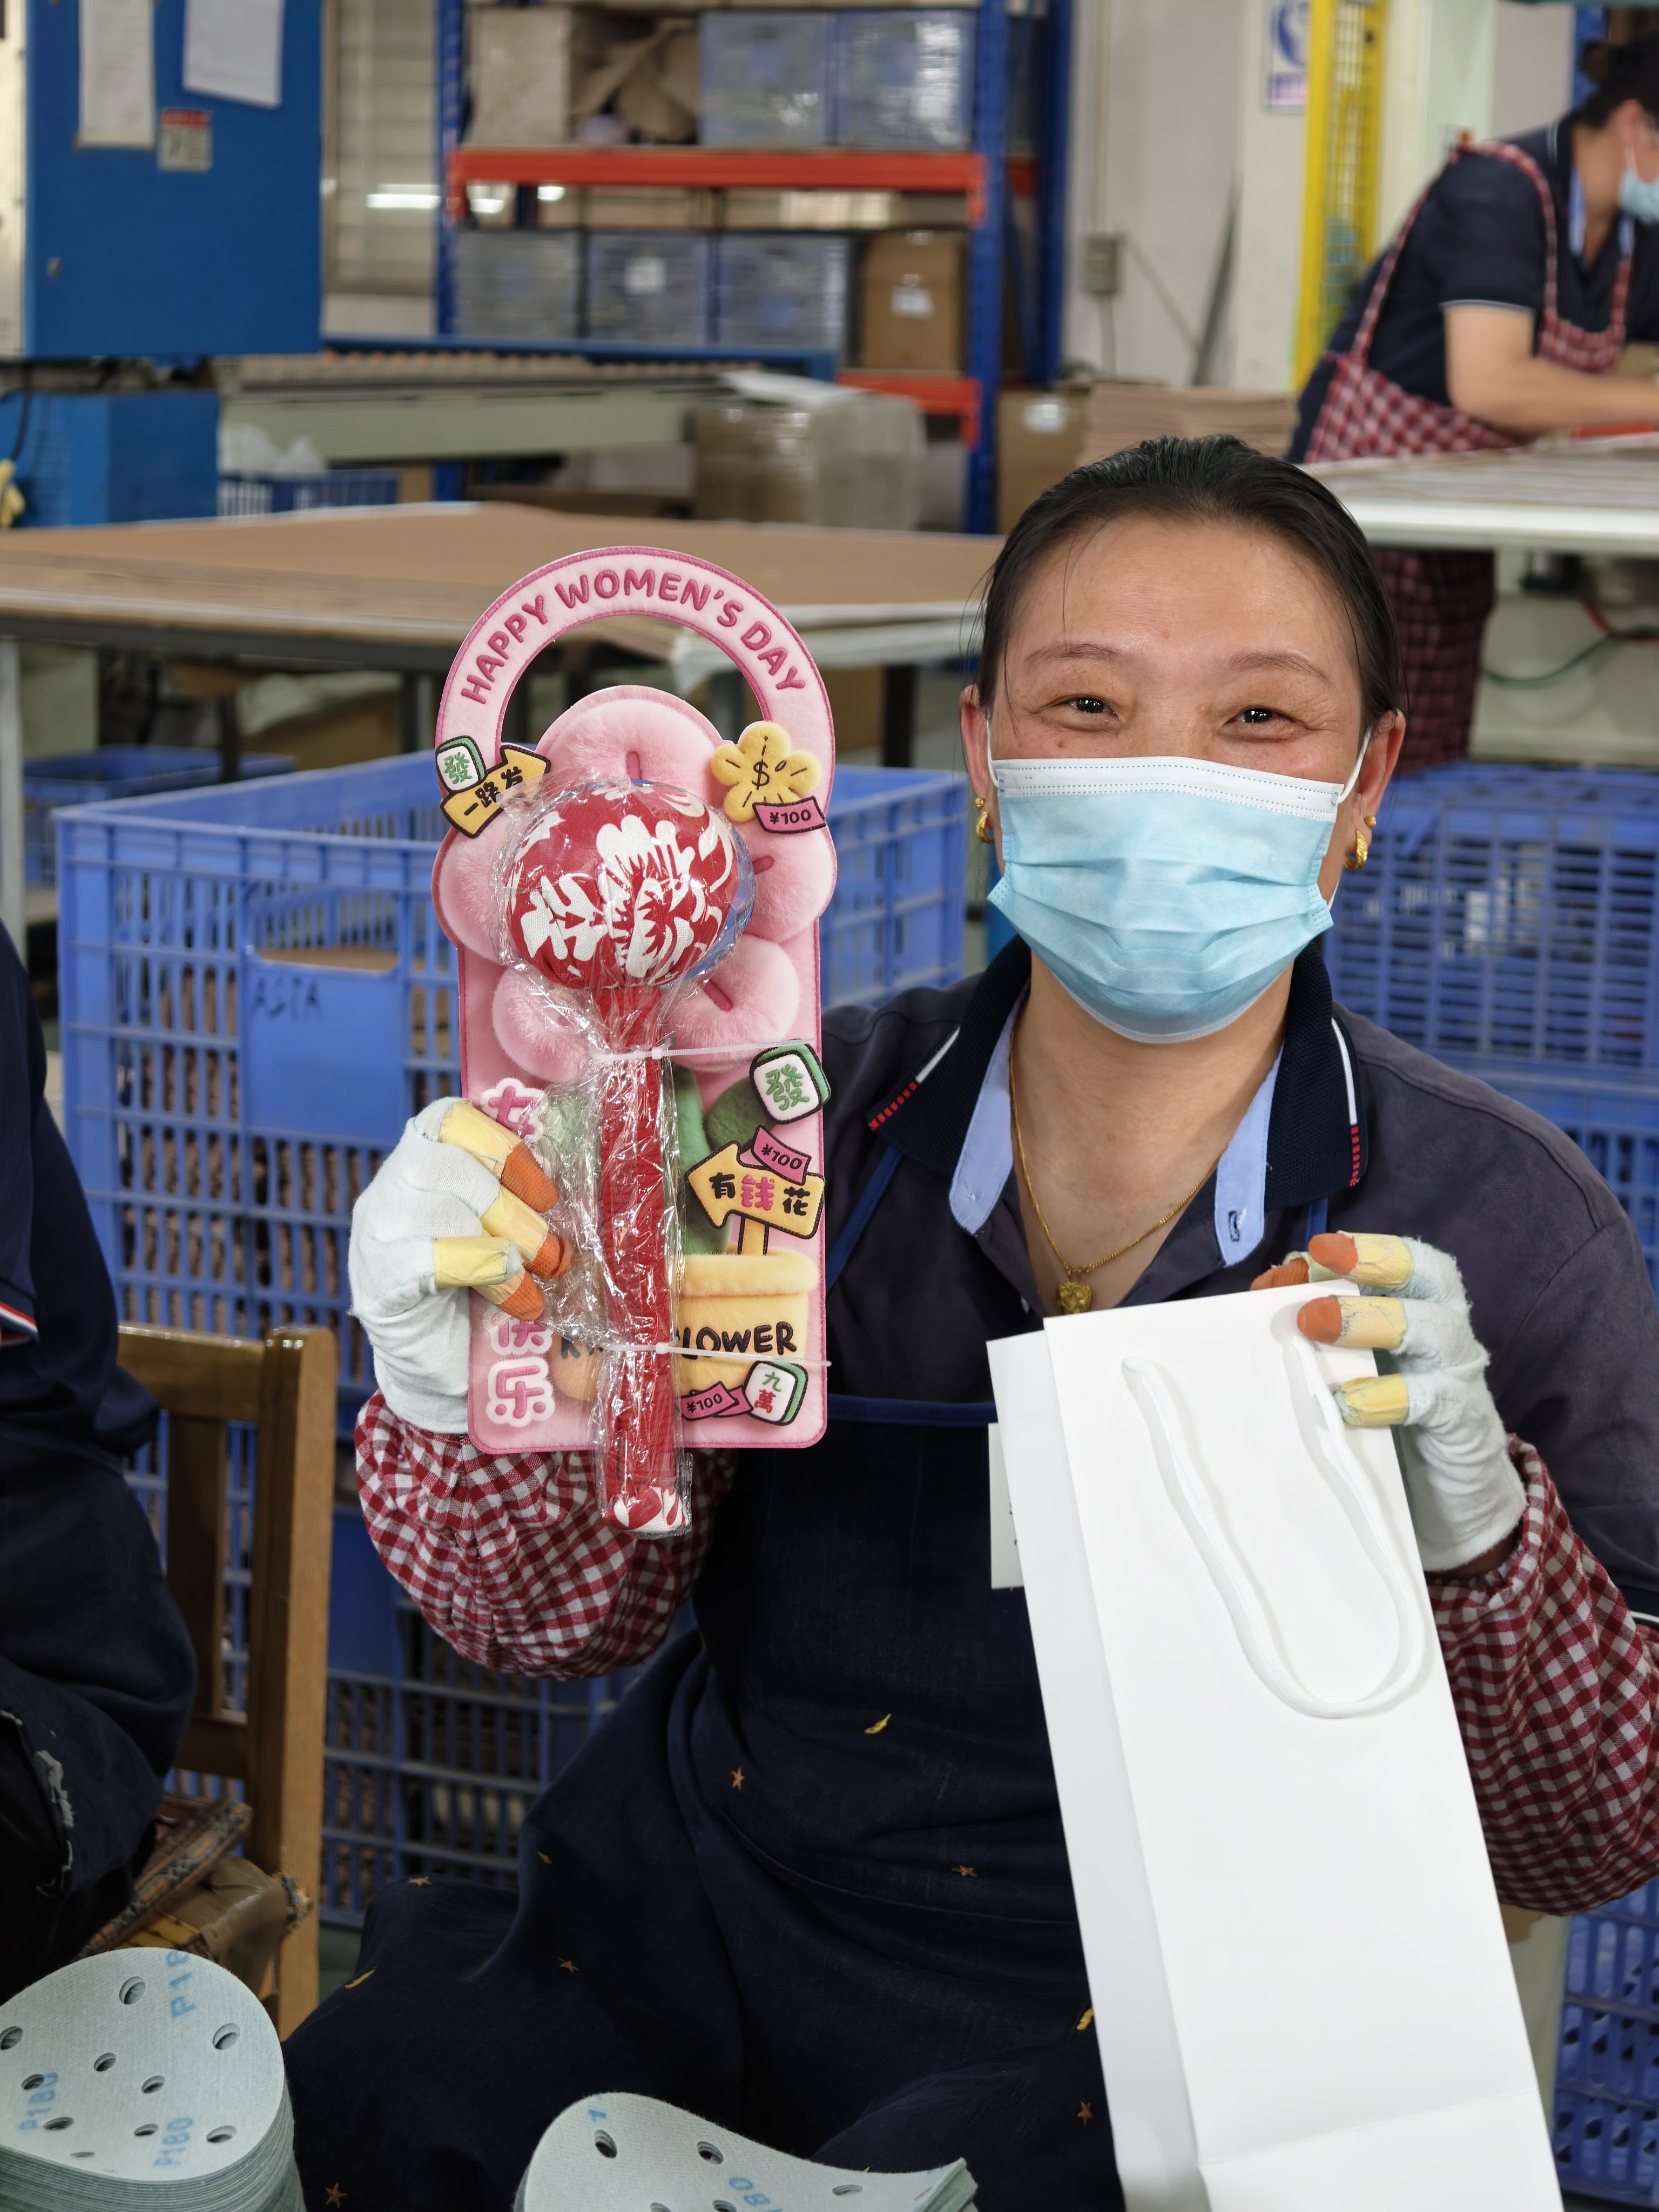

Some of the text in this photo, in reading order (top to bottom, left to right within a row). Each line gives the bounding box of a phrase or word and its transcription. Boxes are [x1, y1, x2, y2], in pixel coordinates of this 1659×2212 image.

[461, 569, 806, 704] HAPPY WOMEN'S DAY
[444, 751, 473, 785] 發
[770, 809, 812, 825] ¥100
[765, 1064, 810, 1111] 發
[761, 1143, 802, 1170] ¥100
[709, 1172, 811, 1216] 有钱花
[676, 1321, 797, 1360] LOWER
[686, 1393, 723, 1413] ¥100
